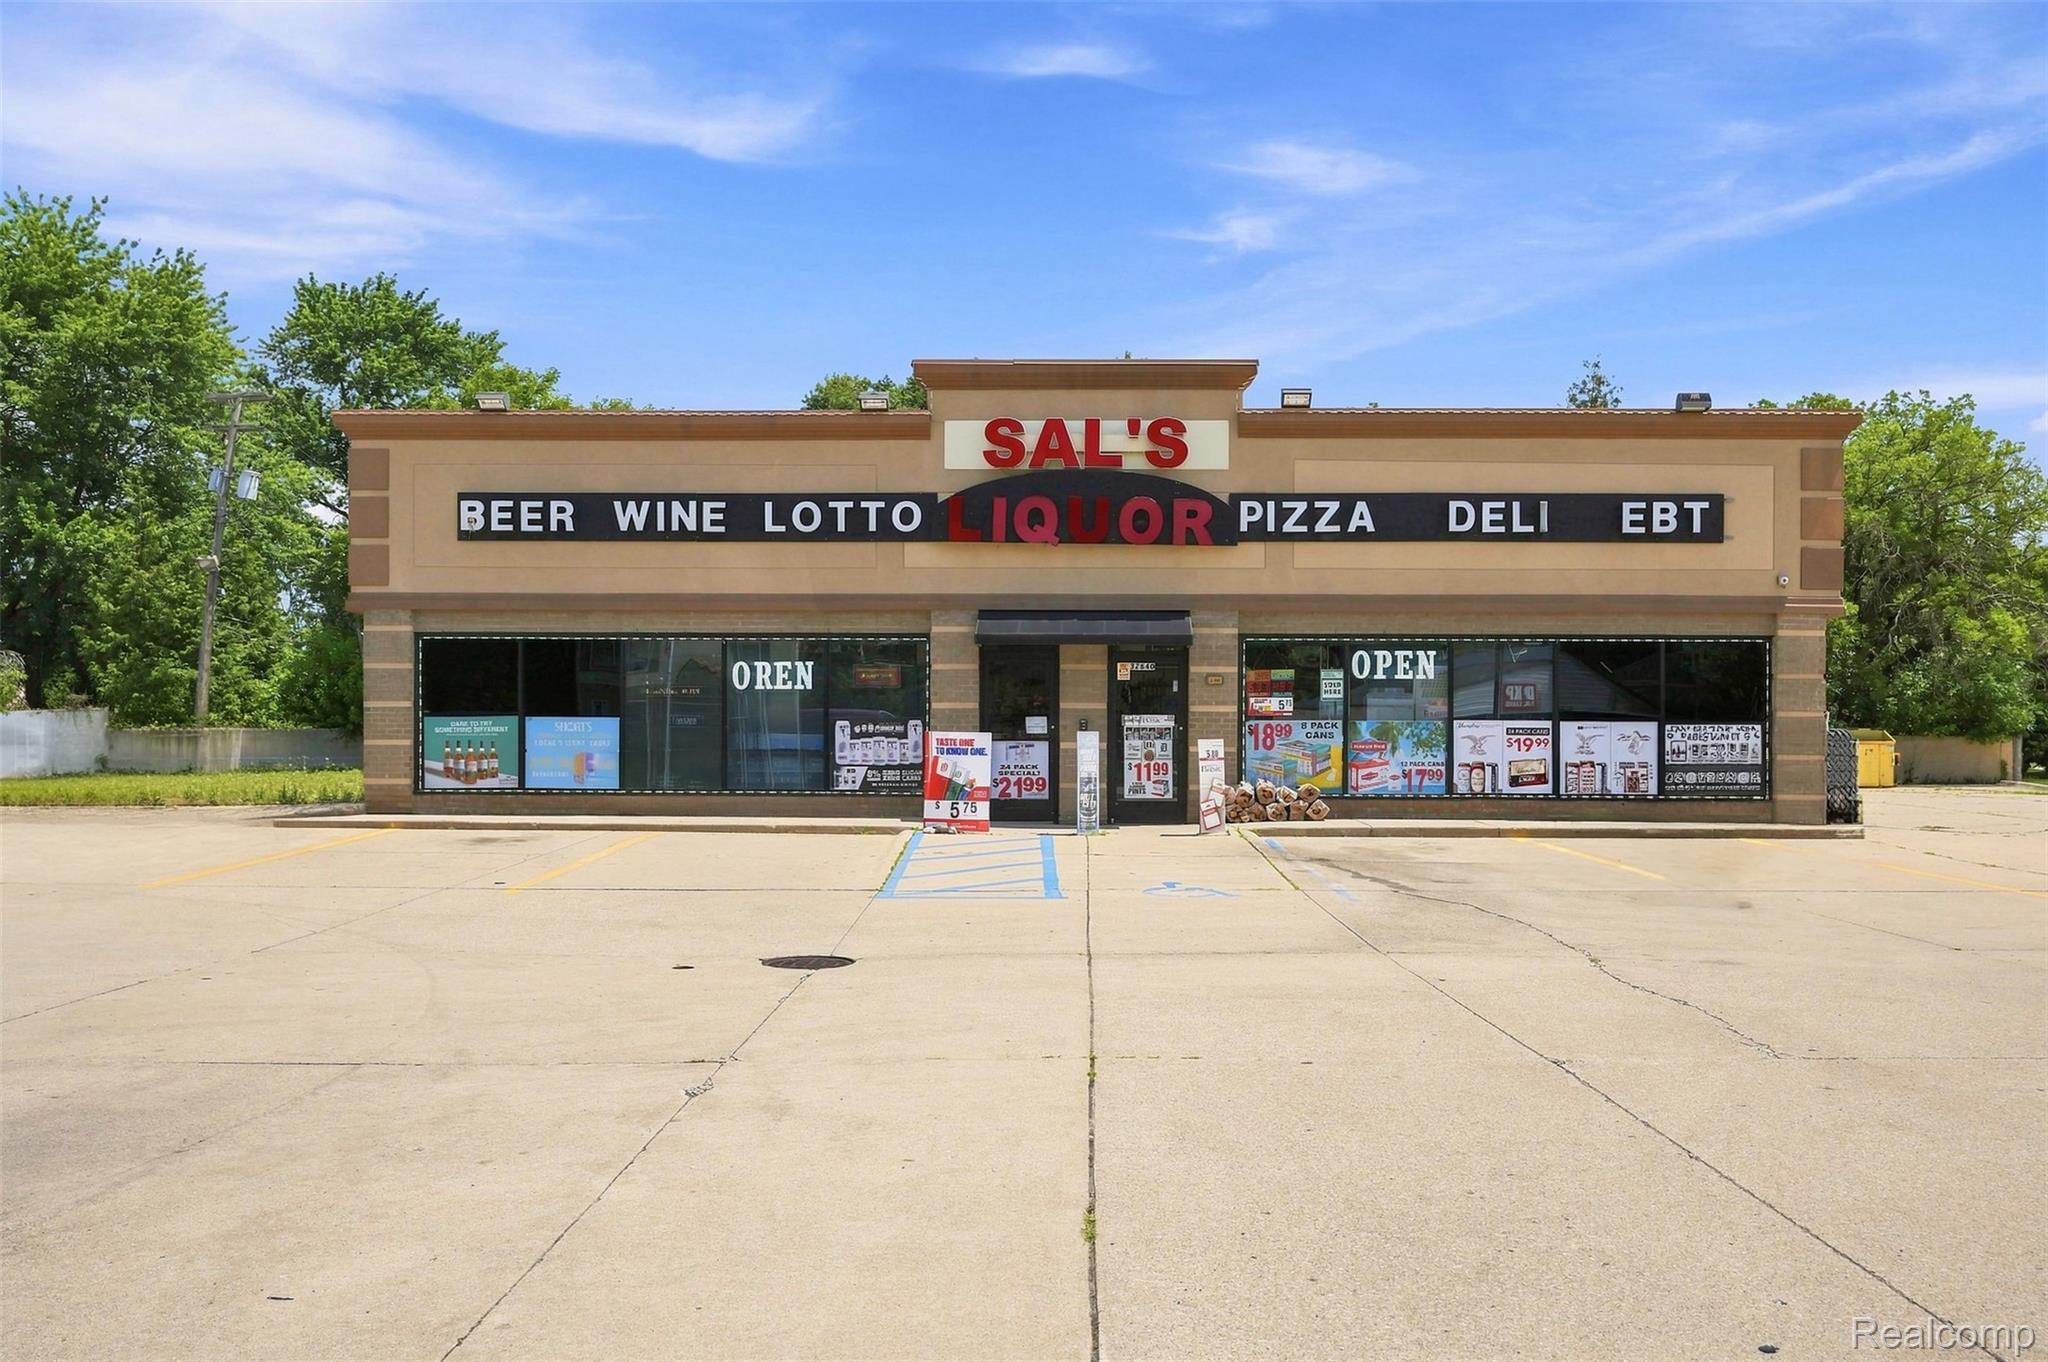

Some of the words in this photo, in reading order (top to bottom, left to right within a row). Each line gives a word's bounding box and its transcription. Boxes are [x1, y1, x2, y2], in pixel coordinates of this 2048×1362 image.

[982, 417, 1189, 469] SAL'S
[460, 500, 575, 532] BEER
[613, 501, 726, 533] WINE
[765, 501, 922, 533] LOTTO
[947, 495, 1214, 546] LIQUOR
[1239, 500, 1375, 533] PIZZA
[1448, 500, 1549, 533] DELI
[1621, 501, 1710, 533] EBT
[1352, 649, 1436, 680] OPEN
[936, 738, 957, 746] TASTE
[936, 747, 944, 755] TO
[946, 747, 968, 755] KNOW
